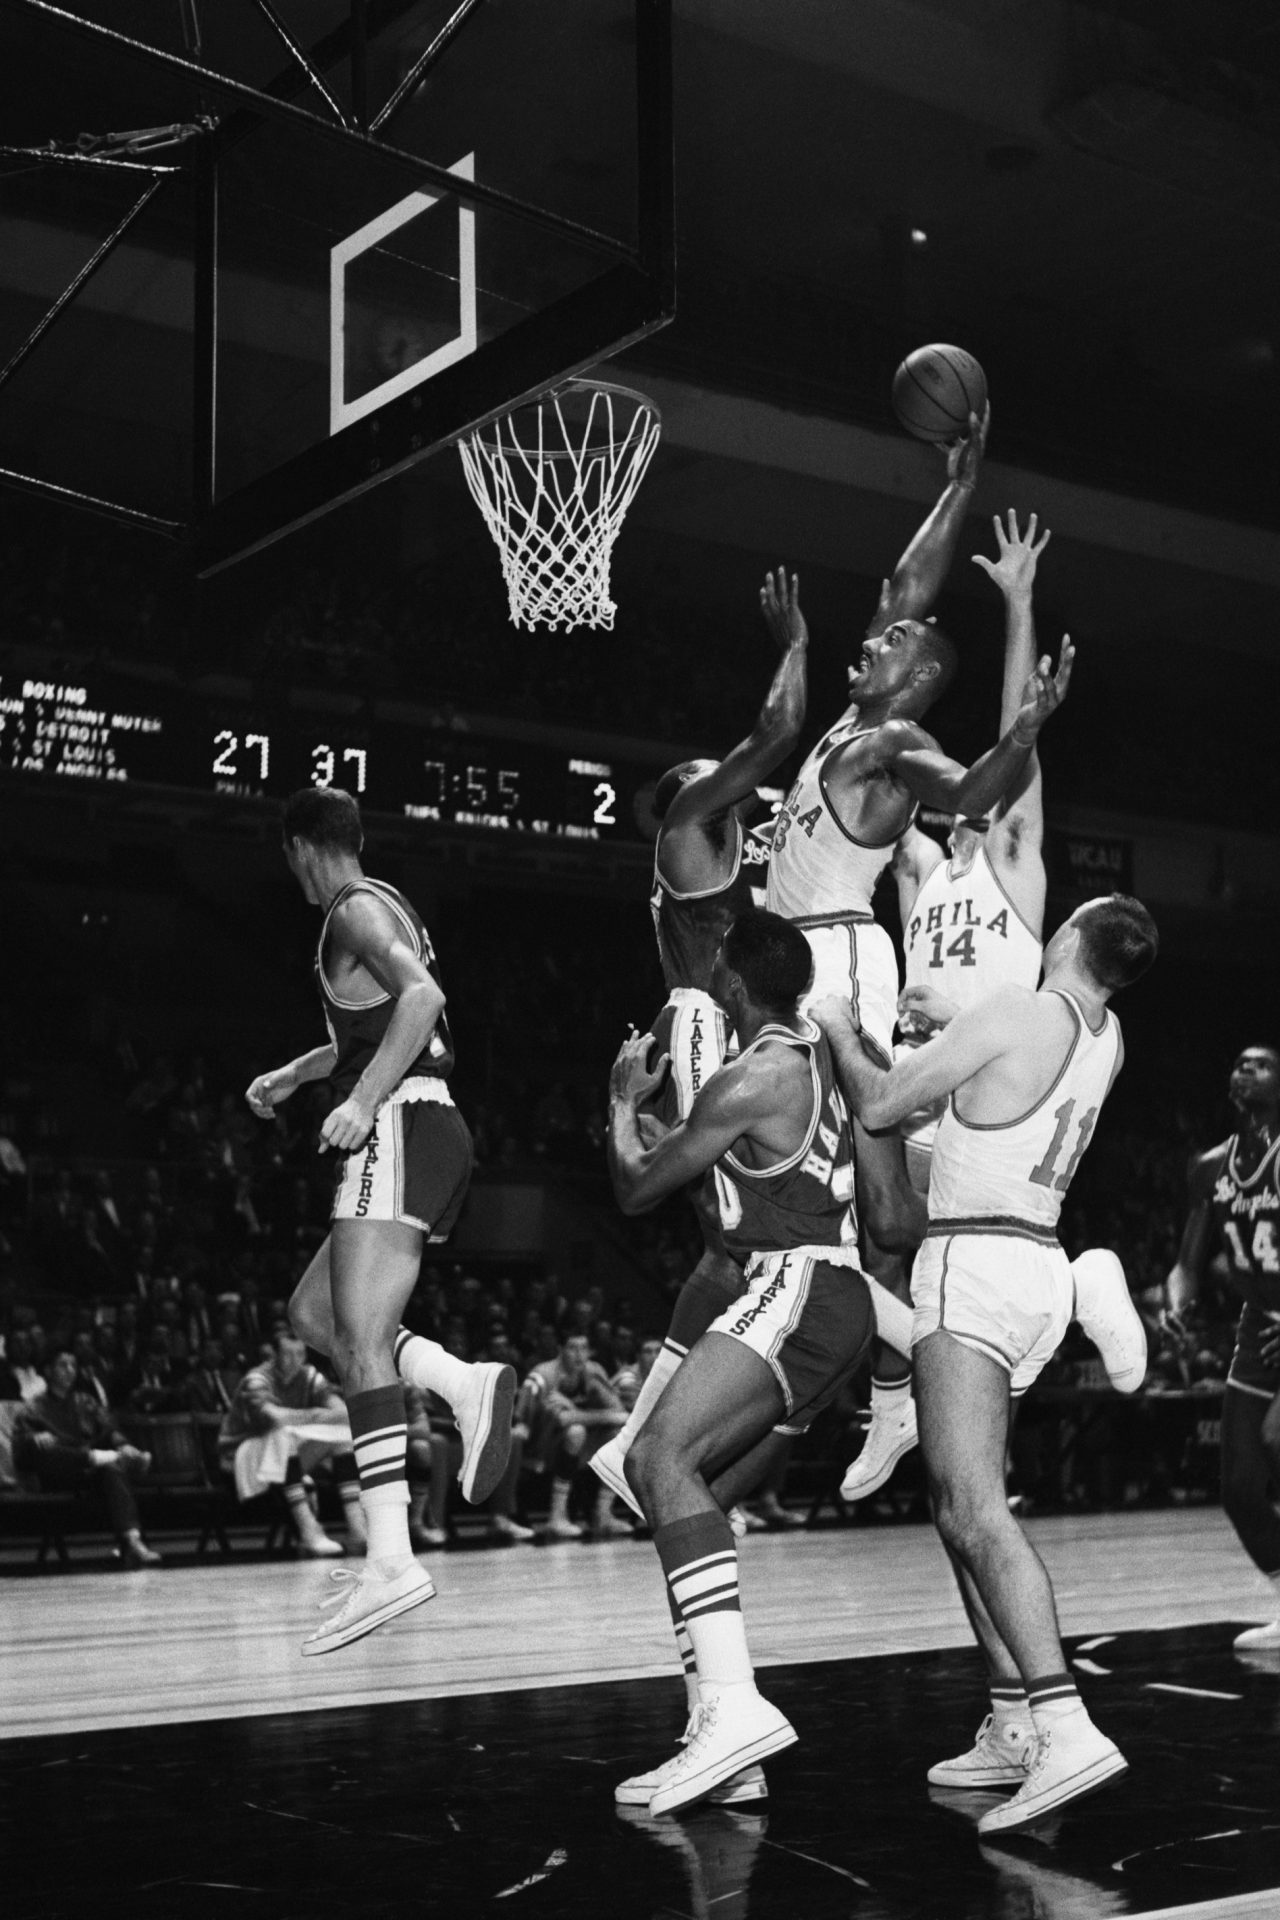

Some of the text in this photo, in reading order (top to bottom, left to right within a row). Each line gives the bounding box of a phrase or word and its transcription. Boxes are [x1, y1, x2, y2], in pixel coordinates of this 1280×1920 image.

[22, 680, 87, 705] BOXING
[62, 743, 116, 765] LOUIS
[212, 730, 269, 779] 27
[311, 744, 366, 792] 37
[424, 760, 519, 810] 7:55
[593, 783, 616, 824] 2
[909, 898, 1008, 952] PHILA
[928, 928, 977, 969] 14
[690, 1008, 704, 1101] LAKER
[1028, 1096, 1098, 1193] 11
[1223, 1220, 1280, 1273] 14
